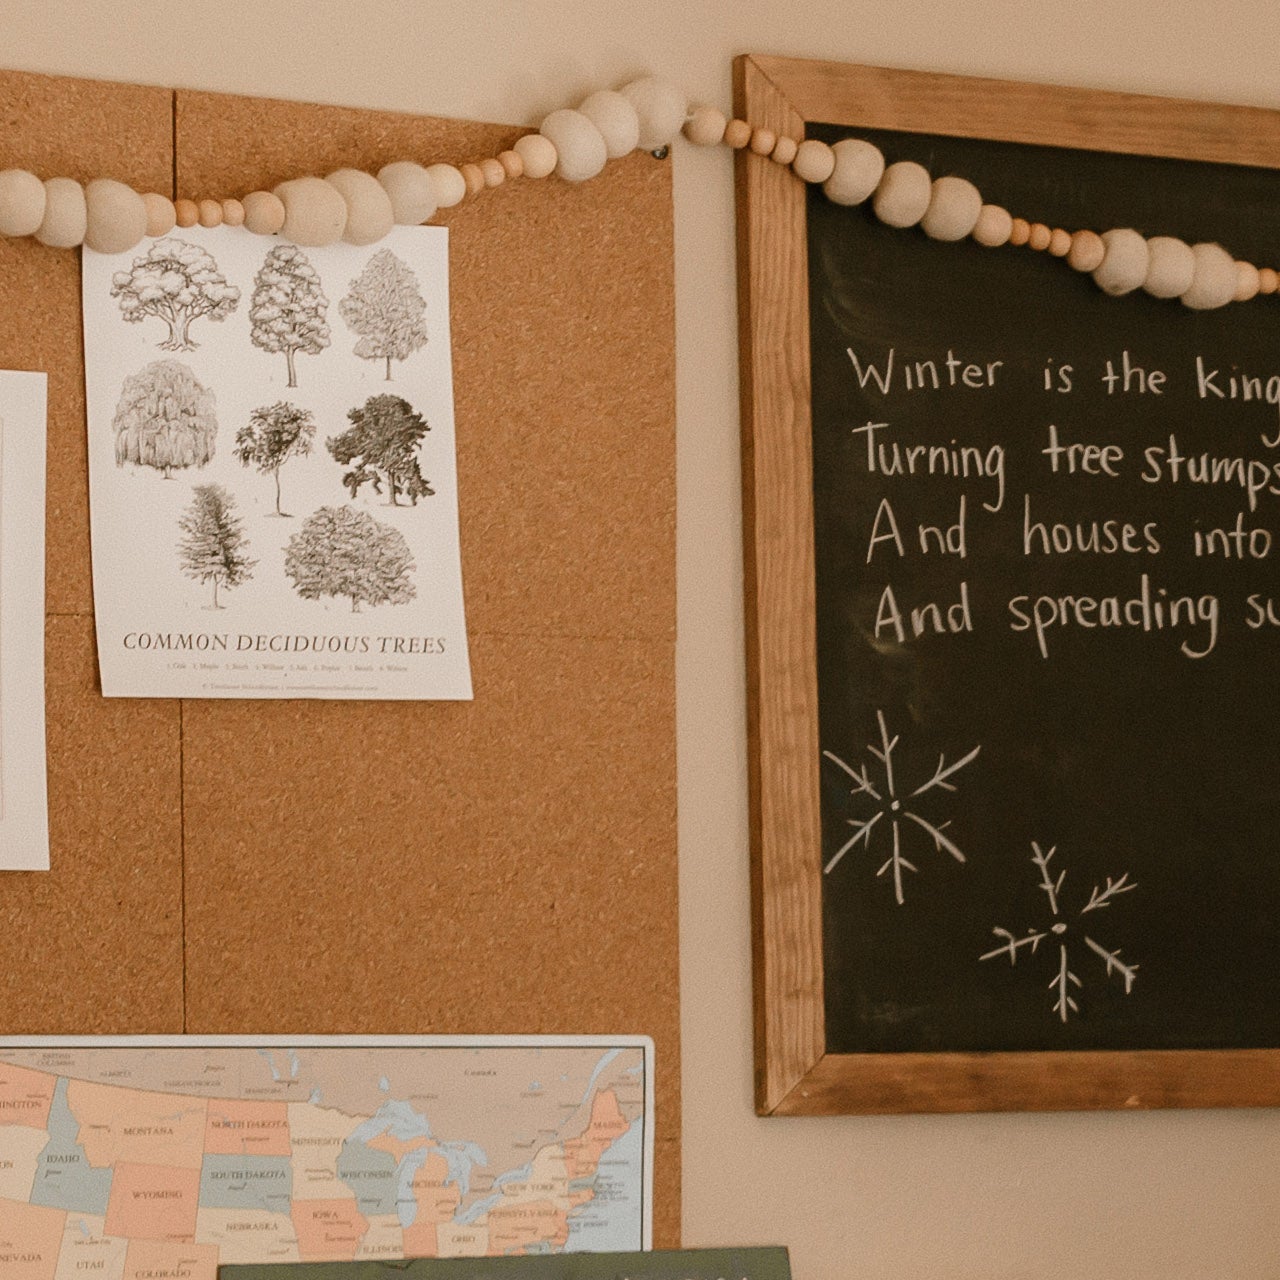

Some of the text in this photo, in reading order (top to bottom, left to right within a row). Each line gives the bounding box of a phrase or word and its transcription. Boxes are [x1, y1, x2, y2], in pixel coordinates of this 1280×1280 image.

[847, 347, 1004, 395] Winter
[1044, 357, 1073, 394] is
[1101, 350, 1167, 395] the
[851, 421, 1005, 513] Turning
[1042, 424, 1125, 477] tree
[866, 494, 967, 564] And
[1024, 493, 1161, 556] houses
[1194, 511, 1271, 559] into
[874, 581, 974, 643] And
[1007, 573, 1219, 660] spreading
[122, 632, 447, 655] COMMON DECIDUOUS TREES
[123, 1128, 174, 1136] MONTANA
[46, 1155, 80, 1163] IDAHO
[245, 1171, 286, 1179] DAKOTA
[132, 1191, 183, 1199] WYOMING
[312, 1211, 339, 1219] IOWA
[76, 1261, 105, 1269] UTAH
[135, 1270, 191, 1279] COLORADO
